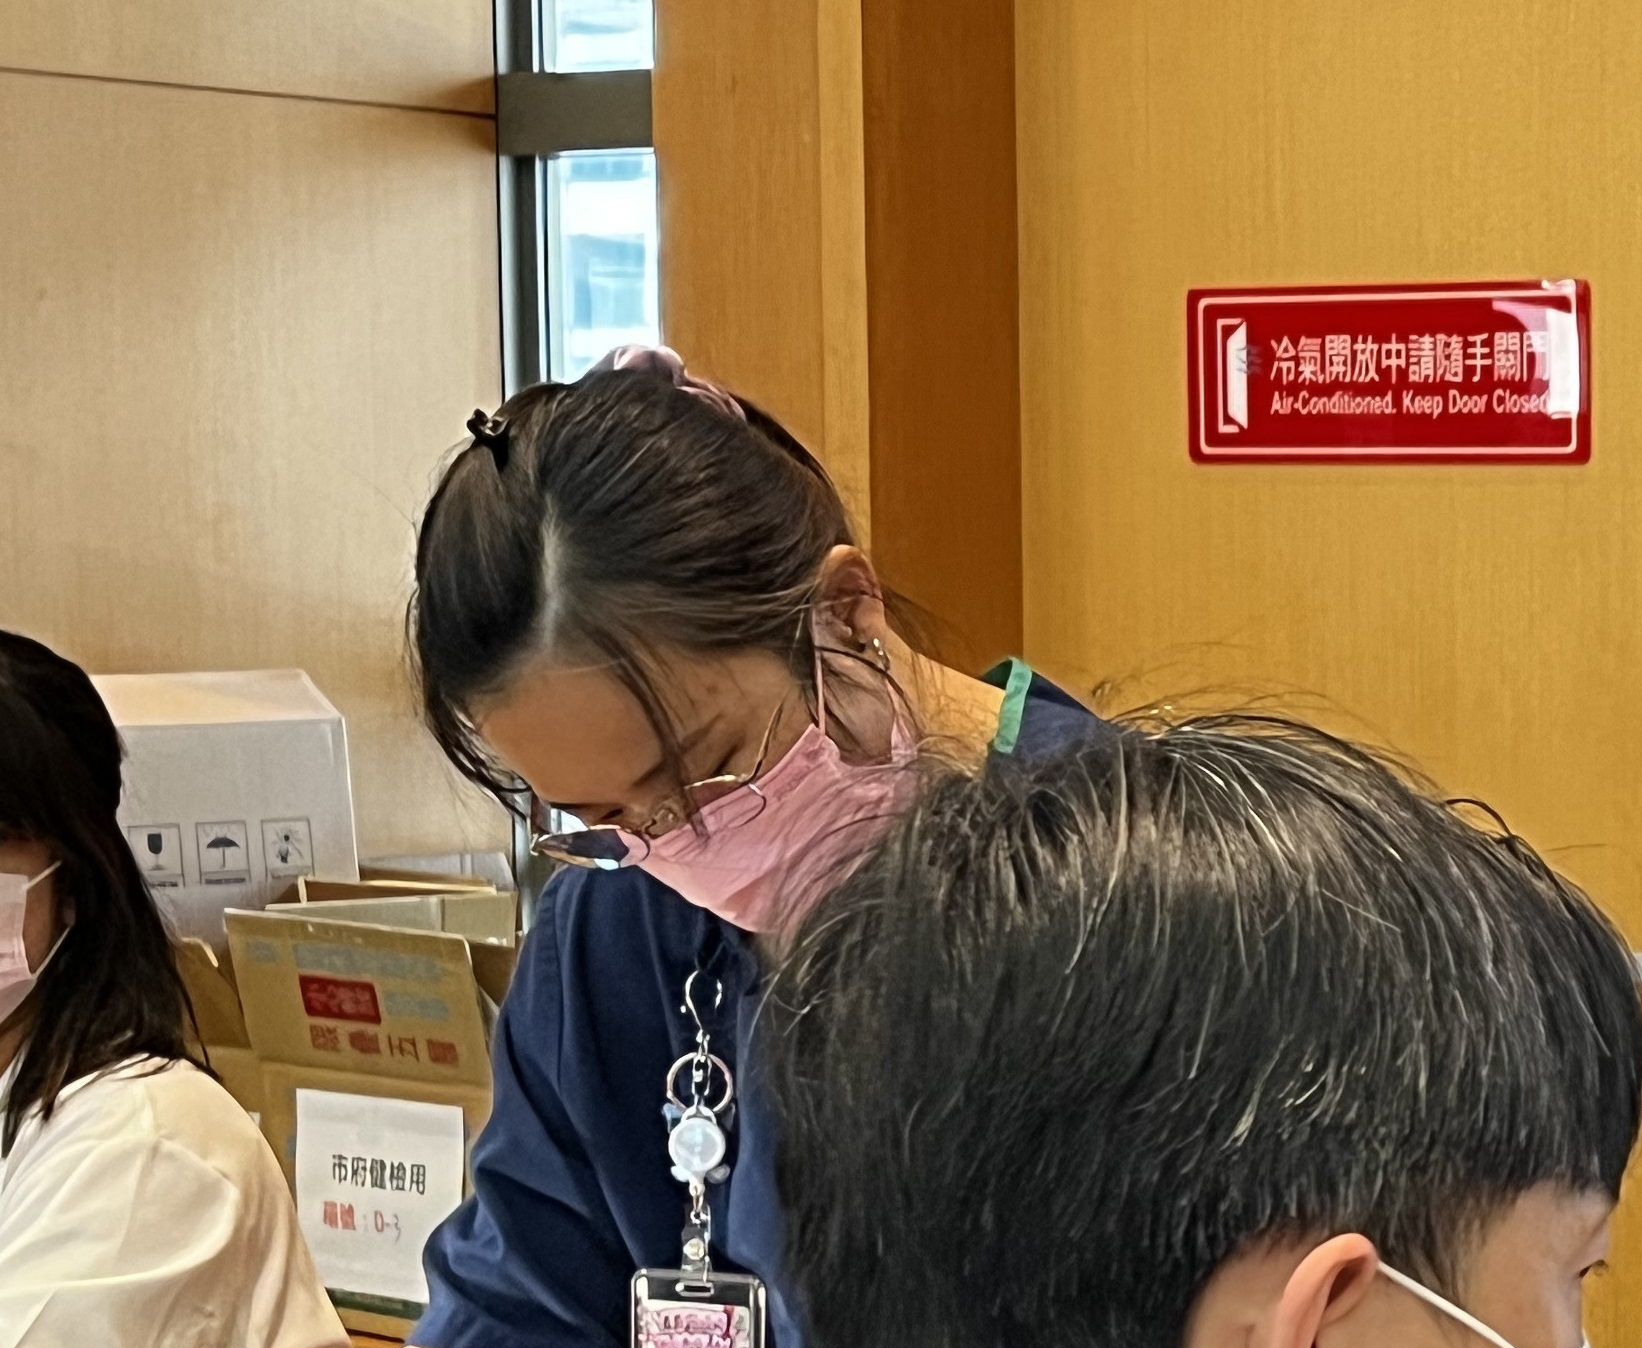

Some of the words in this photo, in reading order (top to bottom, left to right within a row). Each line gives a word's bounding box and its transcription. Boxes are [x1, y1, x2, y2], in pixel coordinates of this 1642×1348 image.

[1270, 331, 1550, 385] 冷氣開放中請隨手關門
[1402, 389, 1443, 420] Keep
[1448, 389, 1488, 414] Door
